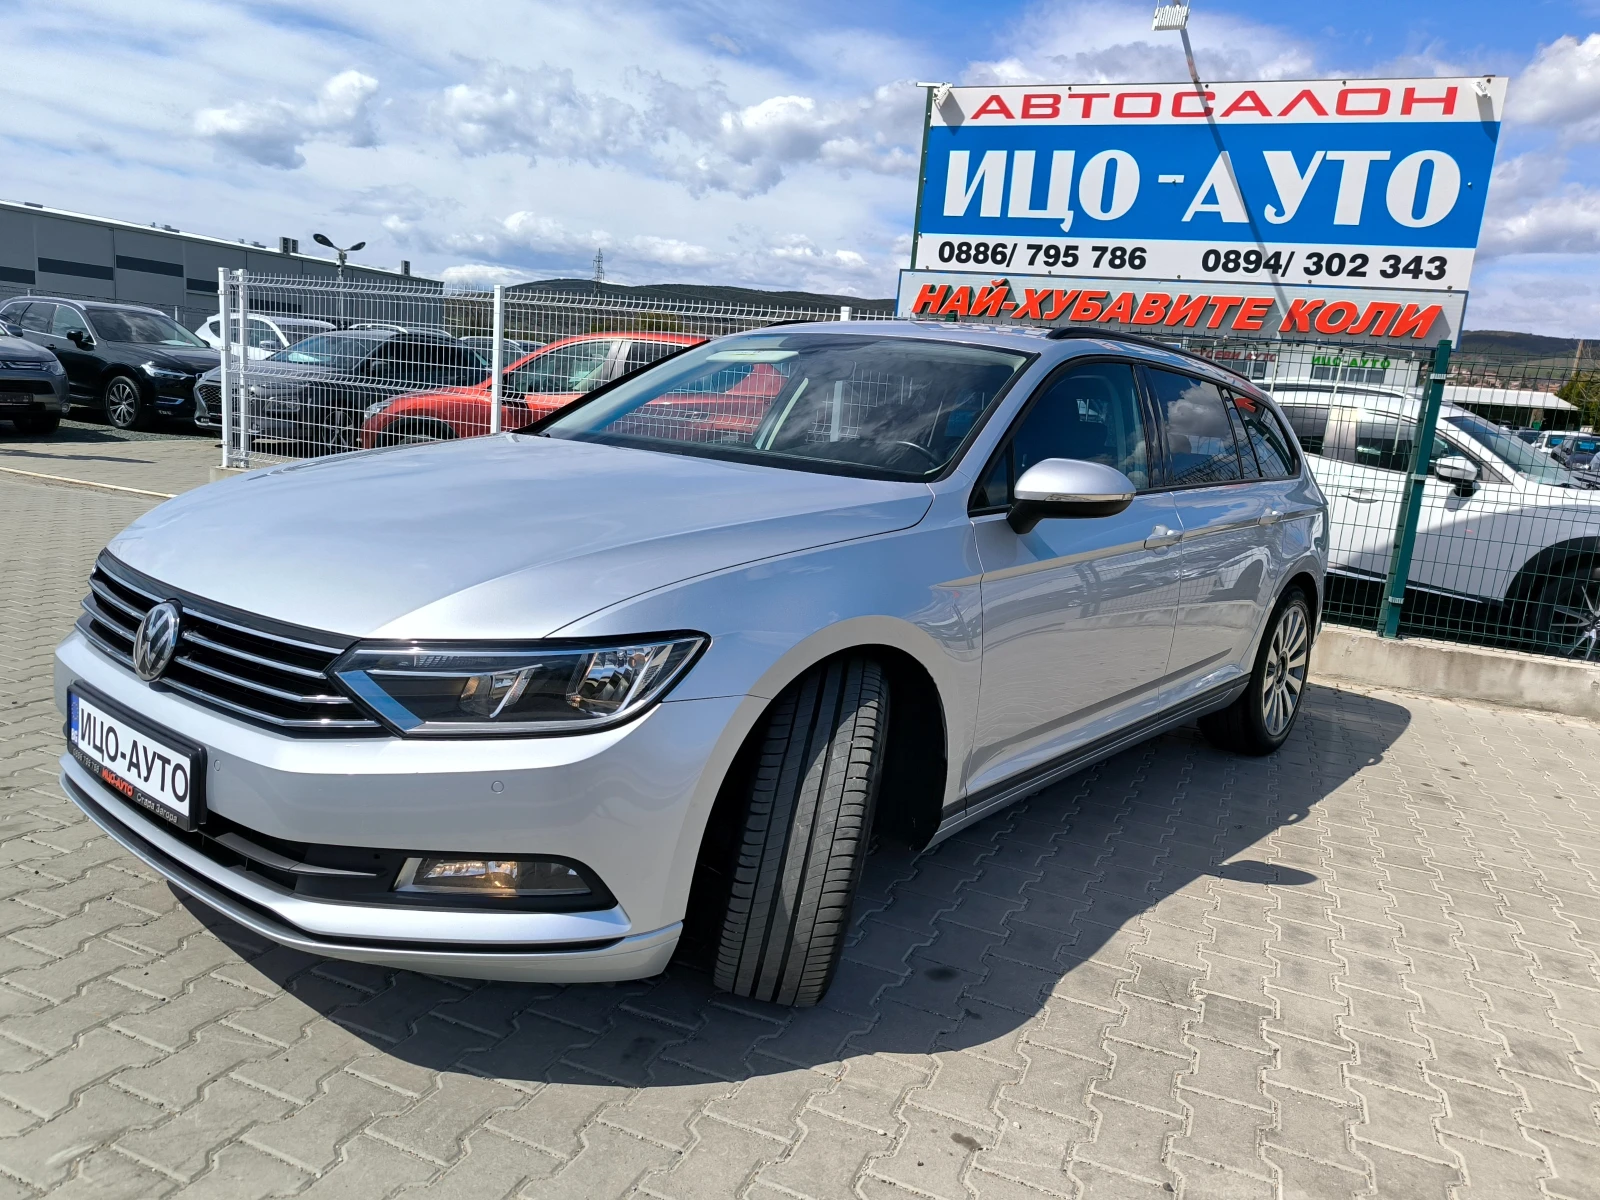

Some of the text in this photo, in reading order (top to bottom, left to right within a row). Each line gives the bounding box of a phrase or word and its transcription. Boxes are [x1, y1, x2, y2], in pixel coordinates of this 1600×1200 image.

[971, 86, 1458, 120] АВТОСАЛОН
[938, 241, 1147, 269] 0886/ 795 786
[1201, 248, 1448, 280] 0894/ 302 343
[911, 278, 1443, 339] НАЙ-ХУБАВИТЕ КОЛИ
[80, 708, 189, 802] ИЦО-АУТО
[136, 792, 178, 823] Стара Загора
